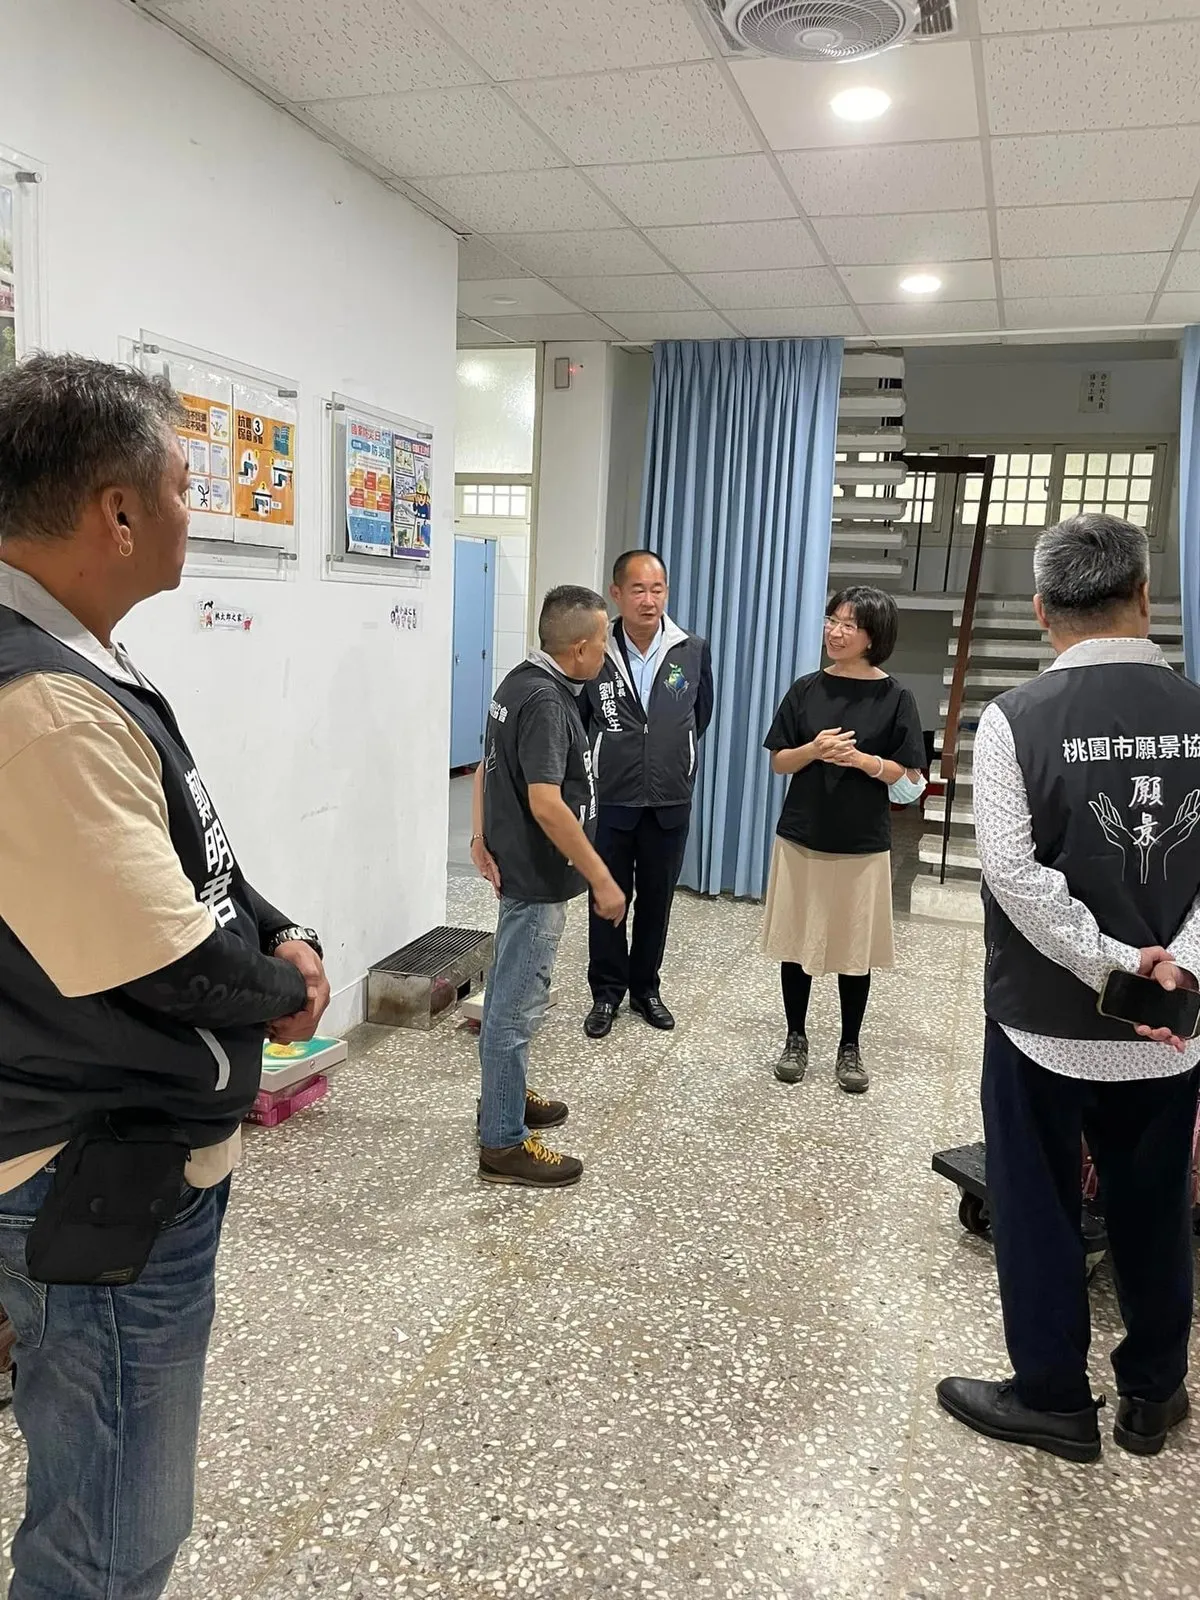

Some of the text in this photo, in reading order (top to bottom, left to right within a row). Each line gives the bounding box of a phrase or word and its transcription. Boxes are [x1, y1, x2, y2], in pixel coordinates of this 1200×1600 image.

[255, 420, 261, 433] 3
[598, 681, 623, 732] 劉俊生
[1128, 775, 1164, 847] 願景
